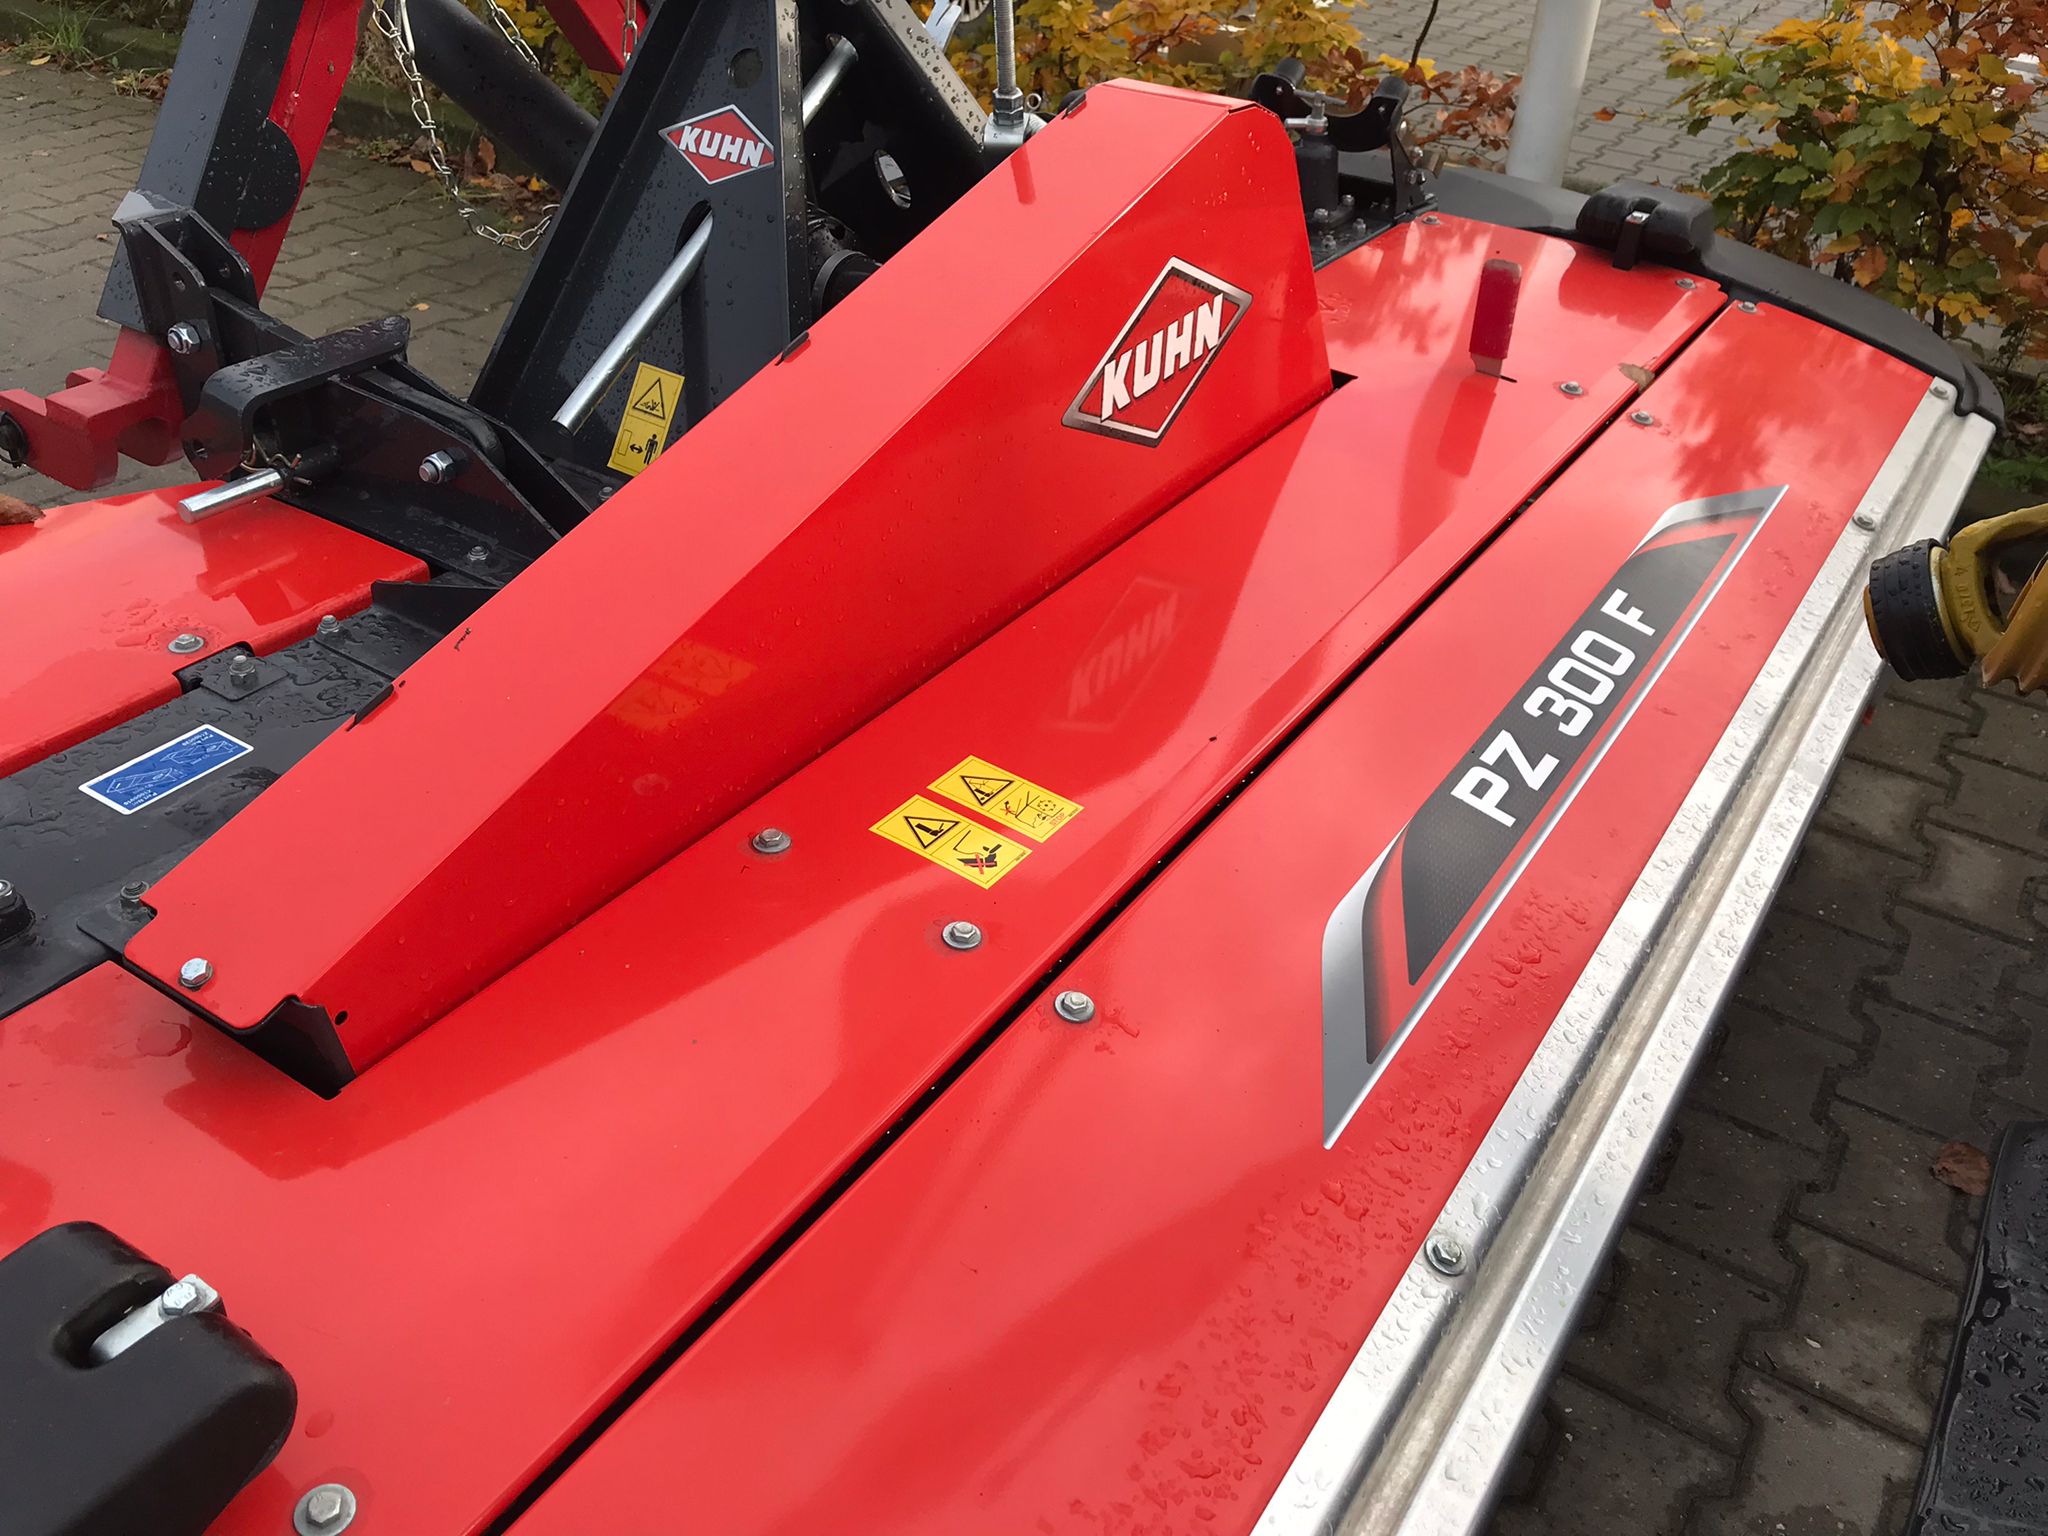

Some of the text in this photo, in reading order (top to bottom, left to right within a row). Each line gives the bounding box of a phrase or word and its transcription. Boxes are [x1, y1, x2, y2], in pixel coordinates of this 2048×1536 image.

[679, 125, 765, 168] KUHN
[1101, 293, 1223, 421] KUHN
[1450, 588, 1656, 828] PZ 300 F
